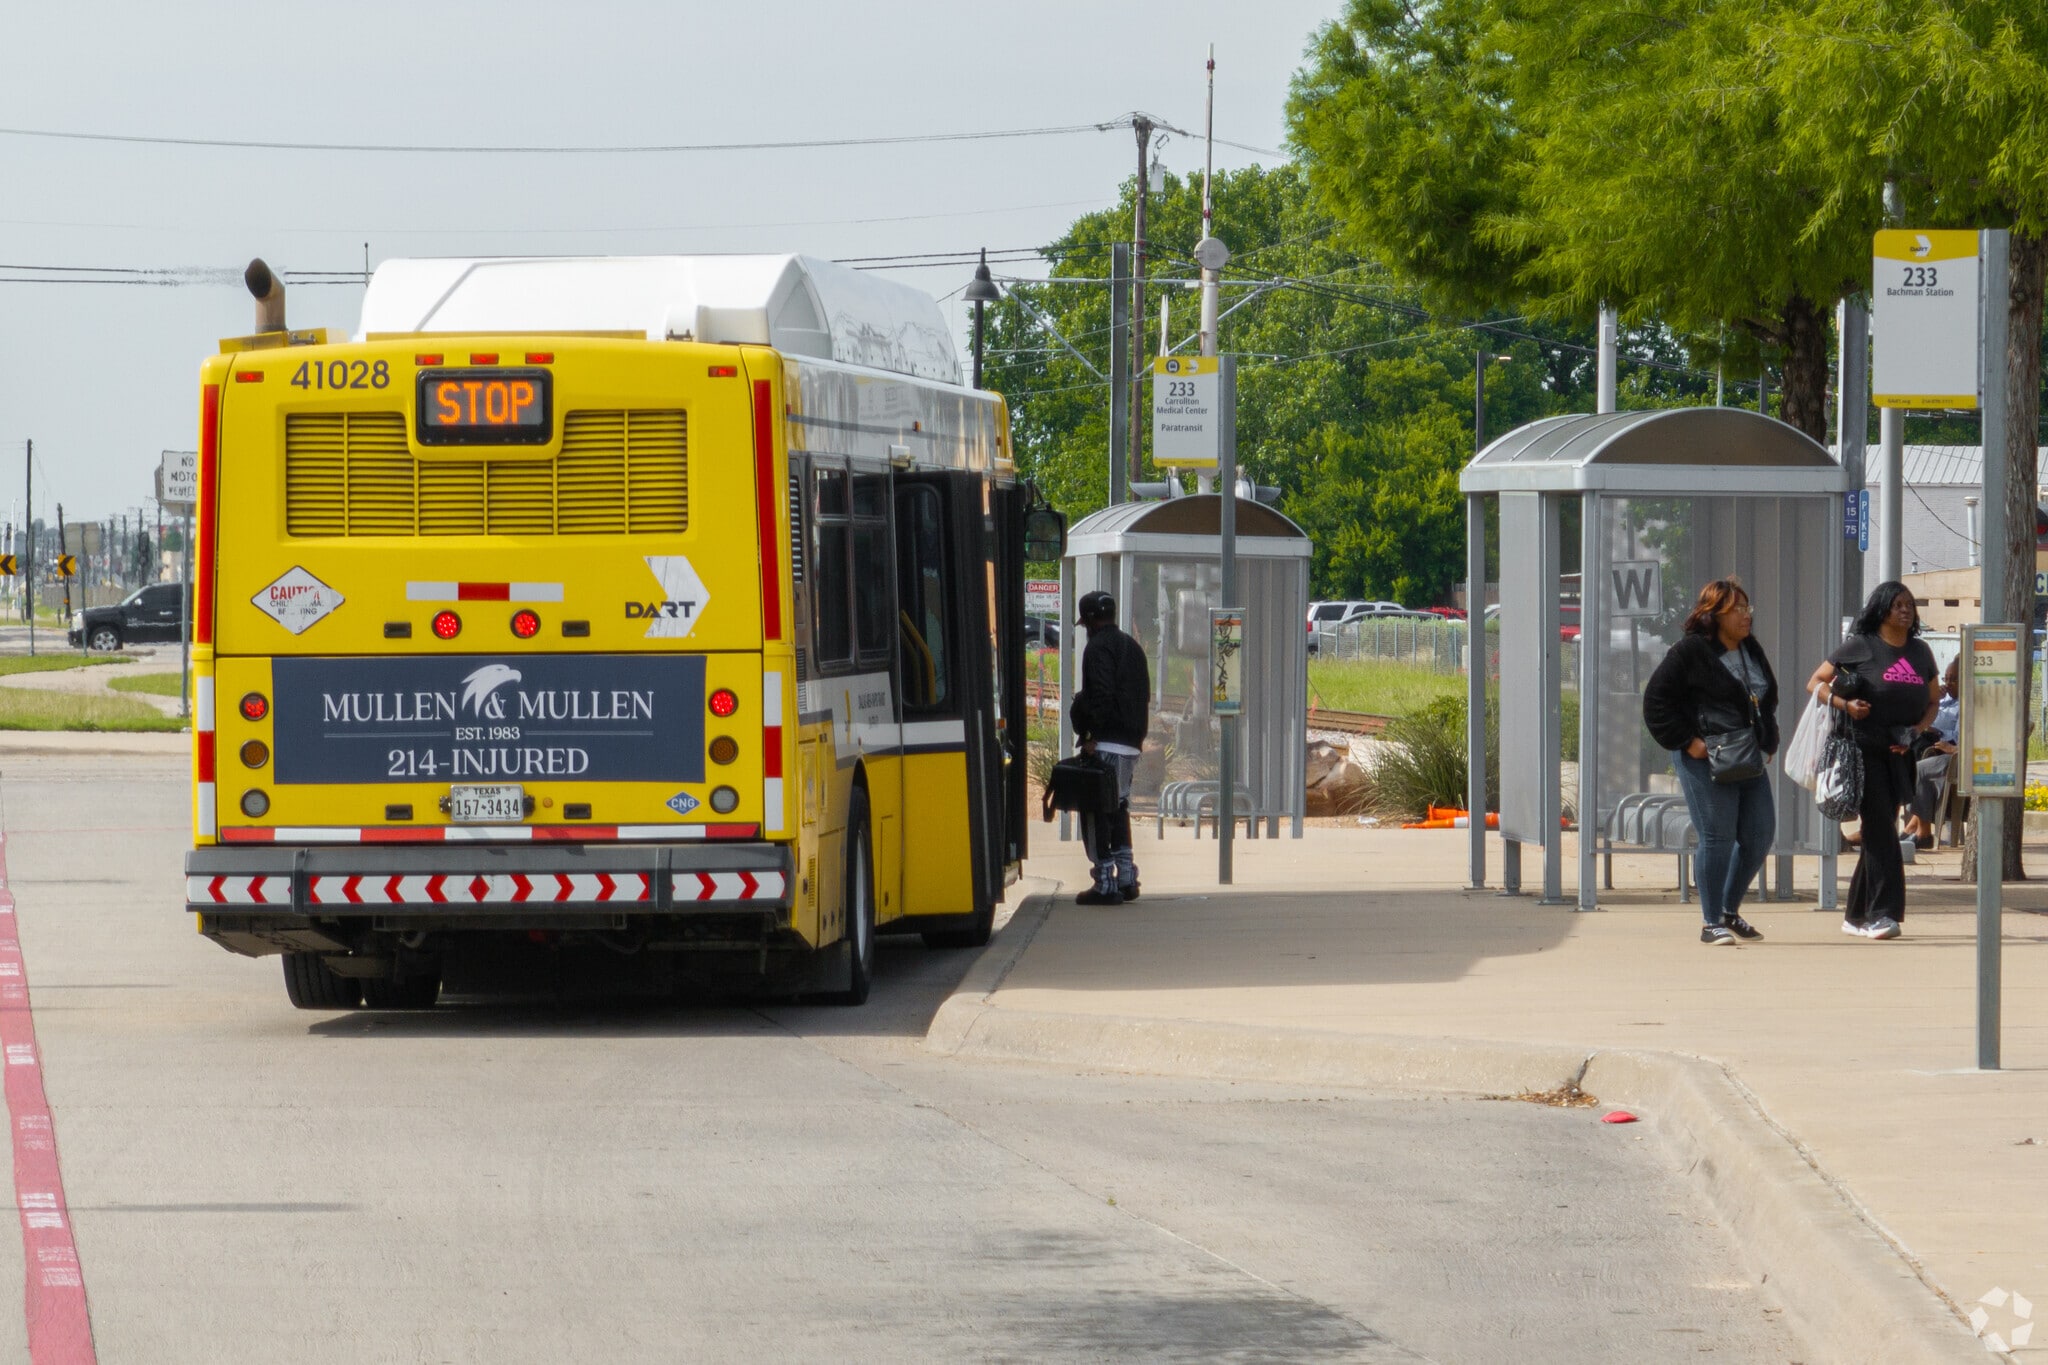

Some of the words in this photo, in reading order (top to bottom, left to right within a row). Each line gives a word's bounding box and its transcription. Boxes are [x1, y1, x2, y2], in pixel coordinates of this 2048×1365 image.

[1903, 267, 1938, 287] 233
[1887, 287, 1923, 296] Bachman
[1926, 287, 1954, 297] Station
[291, 360, 390, 390] 41028
[1169, 382, 1195, 396] 233
[436, 381, 535, 424] STOP
[1165, 397, 1200, 405] Carrollton
[1156, 406, 1183, 414] Medical
[1161, 424, 1203, 432] Paratransit
[181, 457, 195, 467] NO
[171, 471, 198, 482] MOTO
[1848, 494, 1856, 503] C
[1846, 507, 1857, 516] 15
[1845, 525, 1857, 534] 75
[1611, 567, 1653, 609] W
[624, 601, 696, 619] DART
[1973, 655, 1993, 667] 233
[1883, 672, 1924, 685] adidas
[323, 691, 457, 722] MULLEN
[484, 691, 507, 719] &
[518, 690, 654, 720] MULLEN
[455, 728, 486, 740] EST.
[488, 727, 521, 740] 1983
[388, 748, 589, 776] 214-INJURED
[473, 787, 501, 795] TEXAS
[671, 798, 695, 809] CNG
